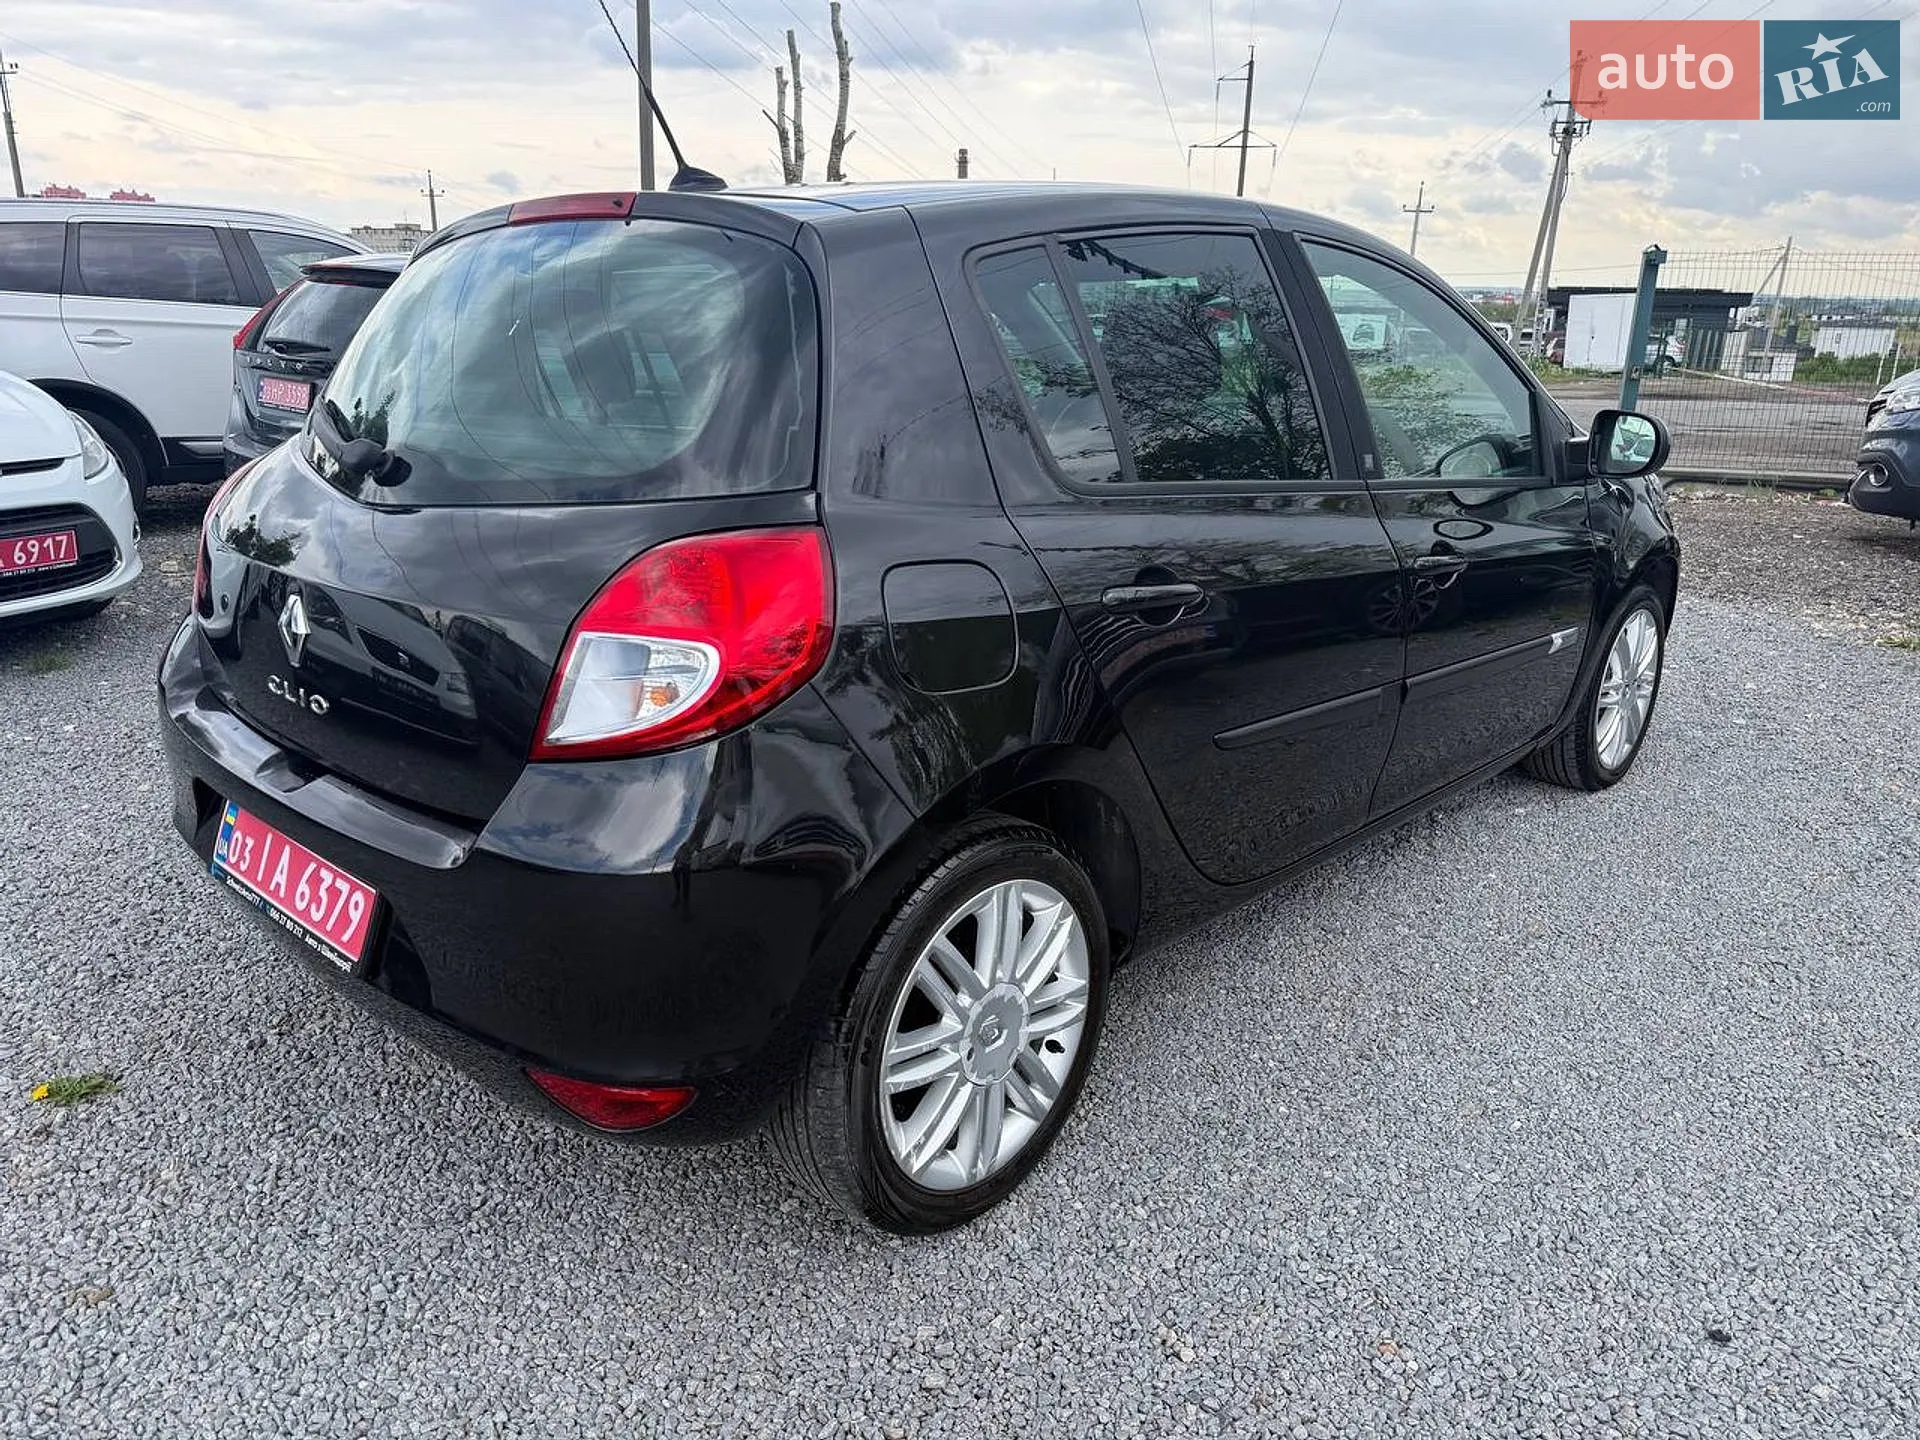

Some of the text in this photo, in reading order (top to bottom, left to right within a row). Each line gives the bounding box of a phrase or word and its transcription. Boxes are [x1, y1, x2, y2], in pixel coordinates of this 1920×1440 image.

[13, 535, 69, 565] 6917
[267, 675, 330, 715] CLIO
[229, 831, 254, 872] 03
[295, 861, 365, 944] 6379
